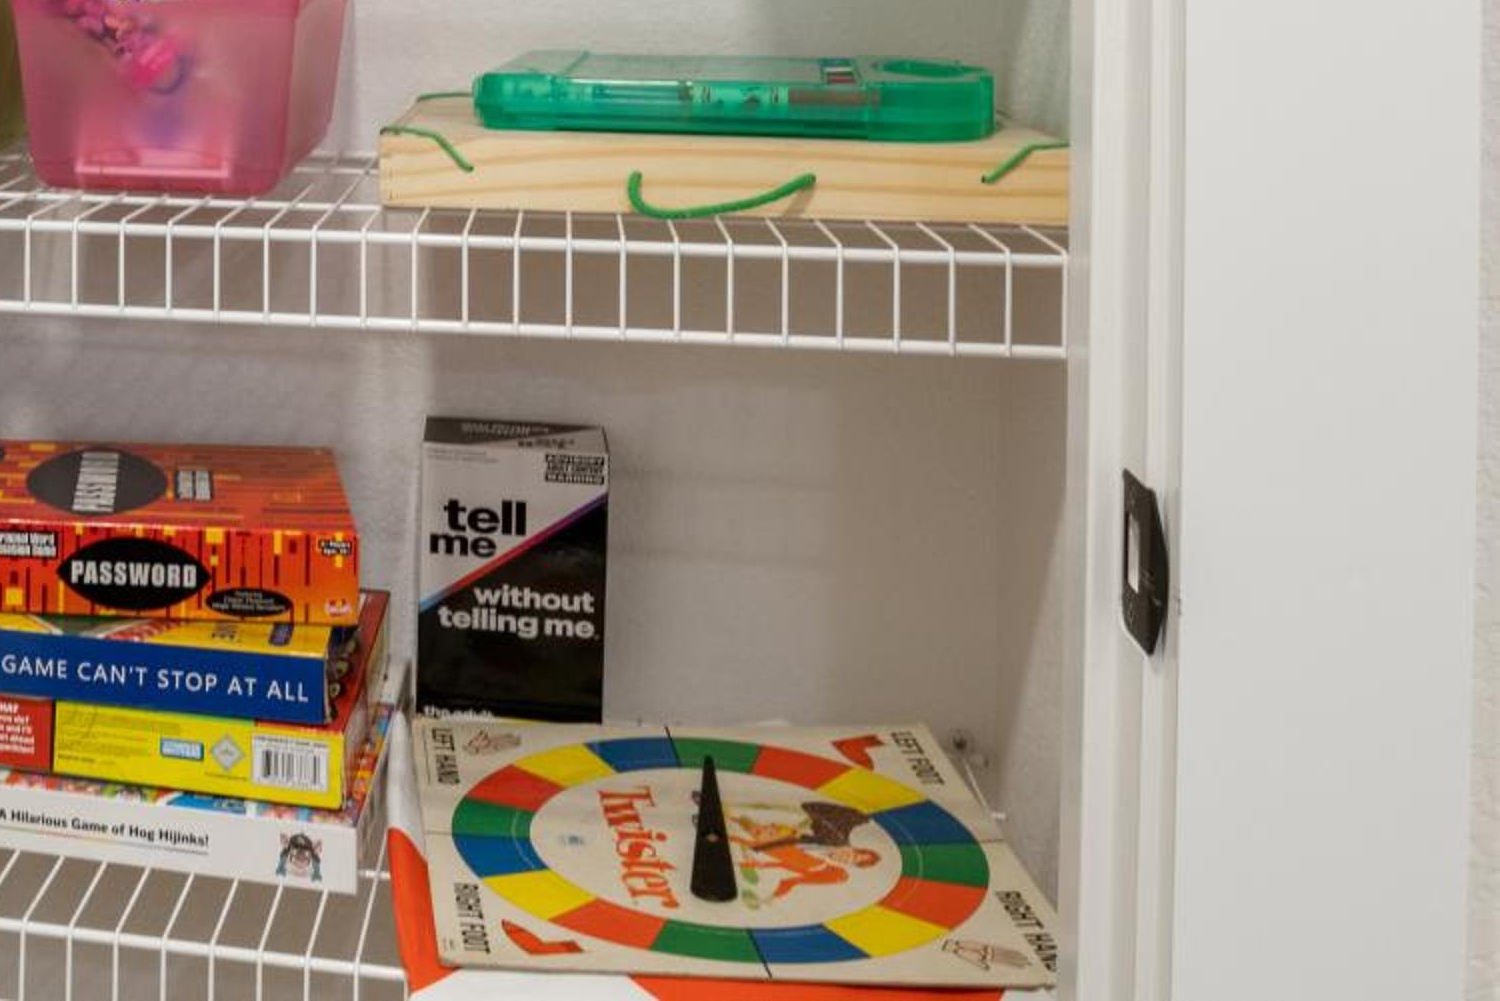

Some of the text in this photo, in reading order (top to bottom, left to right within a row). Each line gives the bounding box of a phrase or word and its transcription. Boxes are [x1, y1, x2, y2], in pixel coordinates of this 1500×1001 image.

[444, 499, 528, 537] tell
[430, 533, 497, 558] me
[71, 558, 197, 590] PASSWORD
[473, 585, 596, 615] without
[438, 606, 540, 640] telling
[1, 654, 68, 680] GAME
[76, 661, 148, 687] CAN'T
[157, 667, 218, 693] STOP
[227, 675, 257, 696] AT
[266, 679, 309, 703] ALL
[0, 702, 19, 714] HAT
[432, 728, 461, 786] LEFT HAND
[891, 731, 945, 786] LEFT FOOT
[10, 809, 68, 829] Hilarious
[71, 817, 109, 832] Game
[111, 824, 125, 836] of
[128, 825, 155, 842] Hog
[159, 828, 210, 847] Hijinks!
[598, 785, 681, 909] Twister
[454, 882, 492, 955] RIGHT FOOT
[996, 890, 1045, 930] RIGHT
